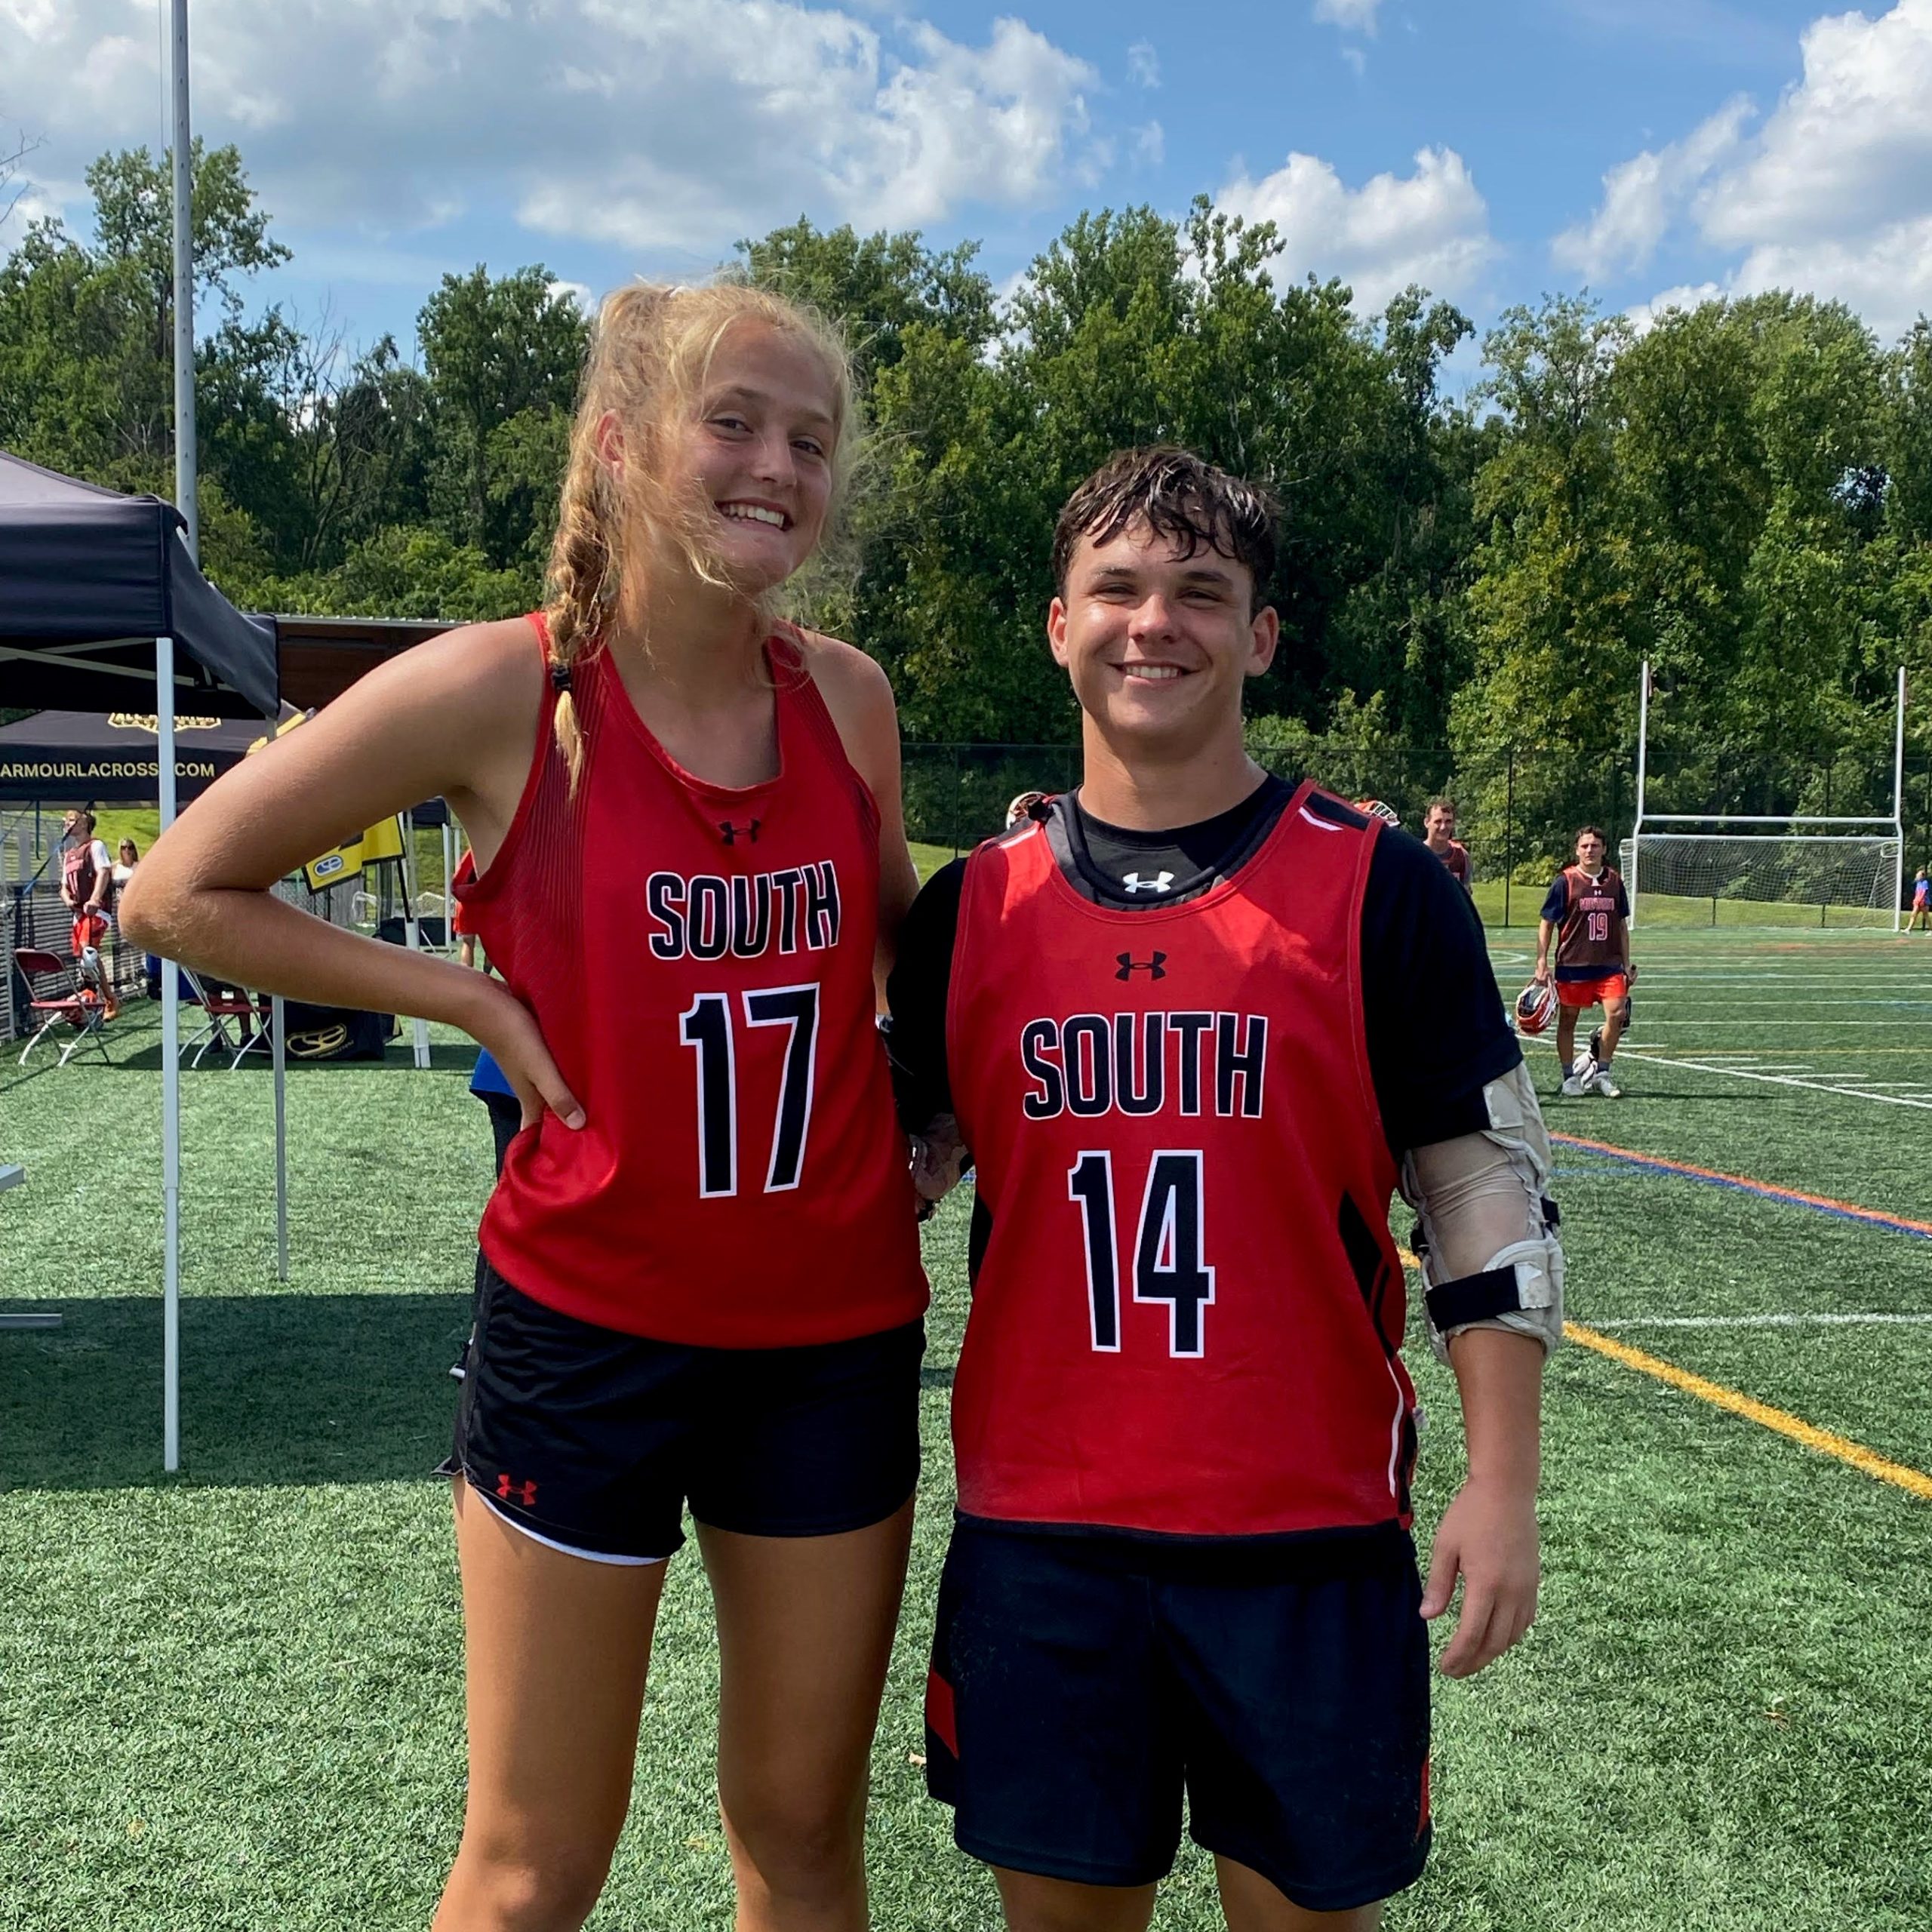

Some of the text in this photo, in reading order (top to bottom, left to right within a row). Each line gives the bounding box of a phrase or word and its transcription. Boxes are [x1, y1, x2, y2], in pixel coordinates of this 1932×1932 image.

[0, 762, 215, 777] ARMOURLACROSSCOM
[647, 860, 841, 961] SOUTH
[1587, 912, 1607, 941] 19
[679, 982, 820, 1198] 17
[1021, 1011, 1269, 1120] SOUTH
[1068, 1149, 1215, 1358] 14
